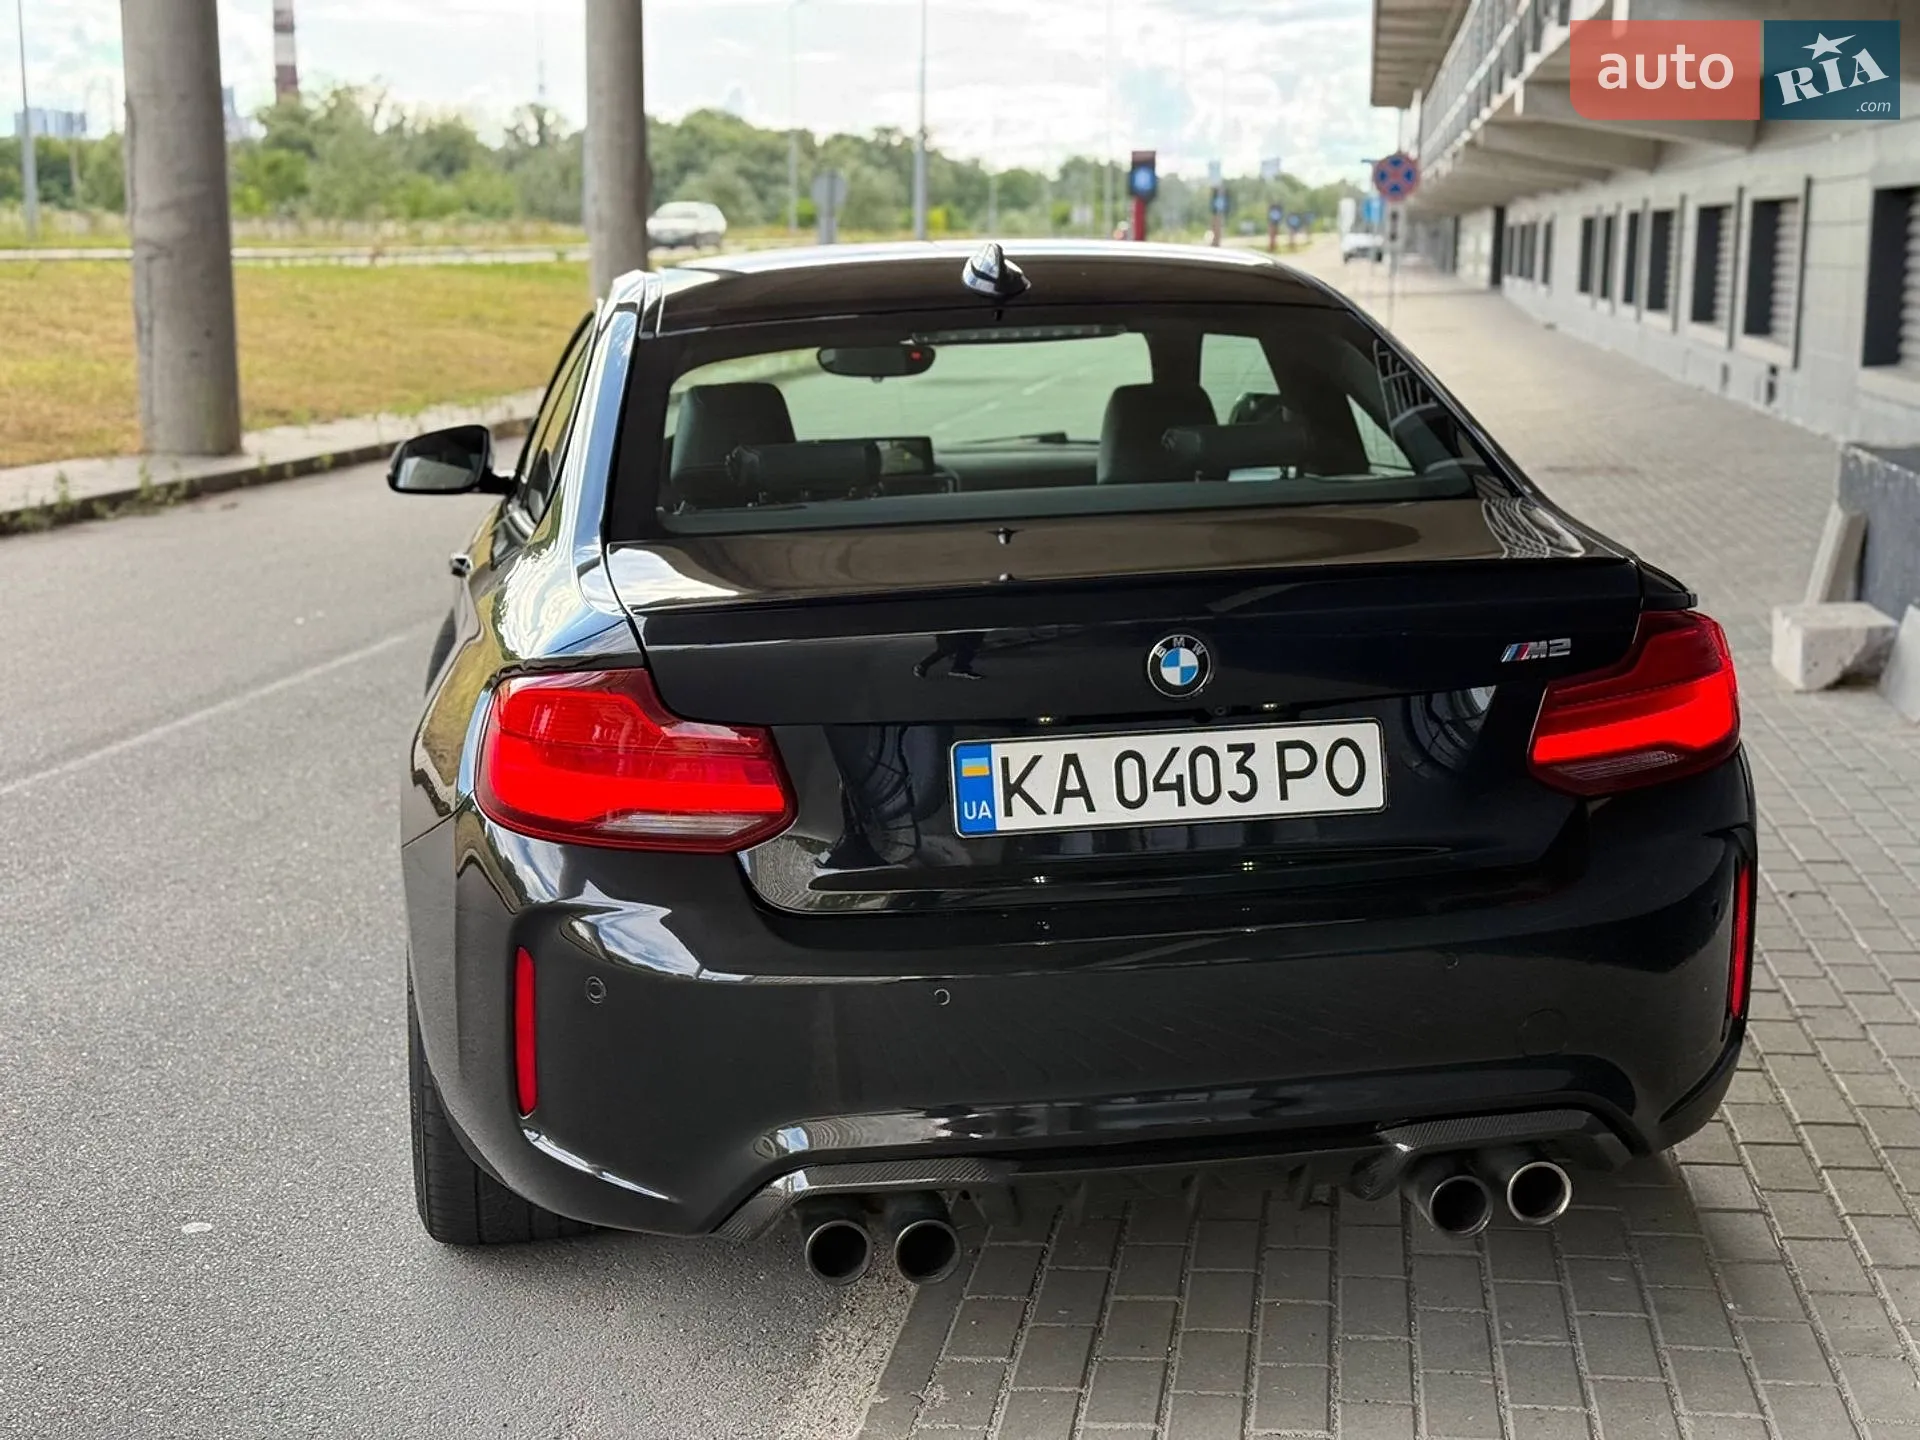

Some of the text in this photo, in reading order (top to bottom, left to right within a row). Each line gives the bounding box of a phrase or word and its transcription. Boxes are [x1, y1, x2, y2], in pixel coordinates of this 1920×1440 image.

[1154, 637, 1206, 658] BMW
[999, 736, 1367, 818] KA 0403 PO
[963, 800, 992, 821] UA
